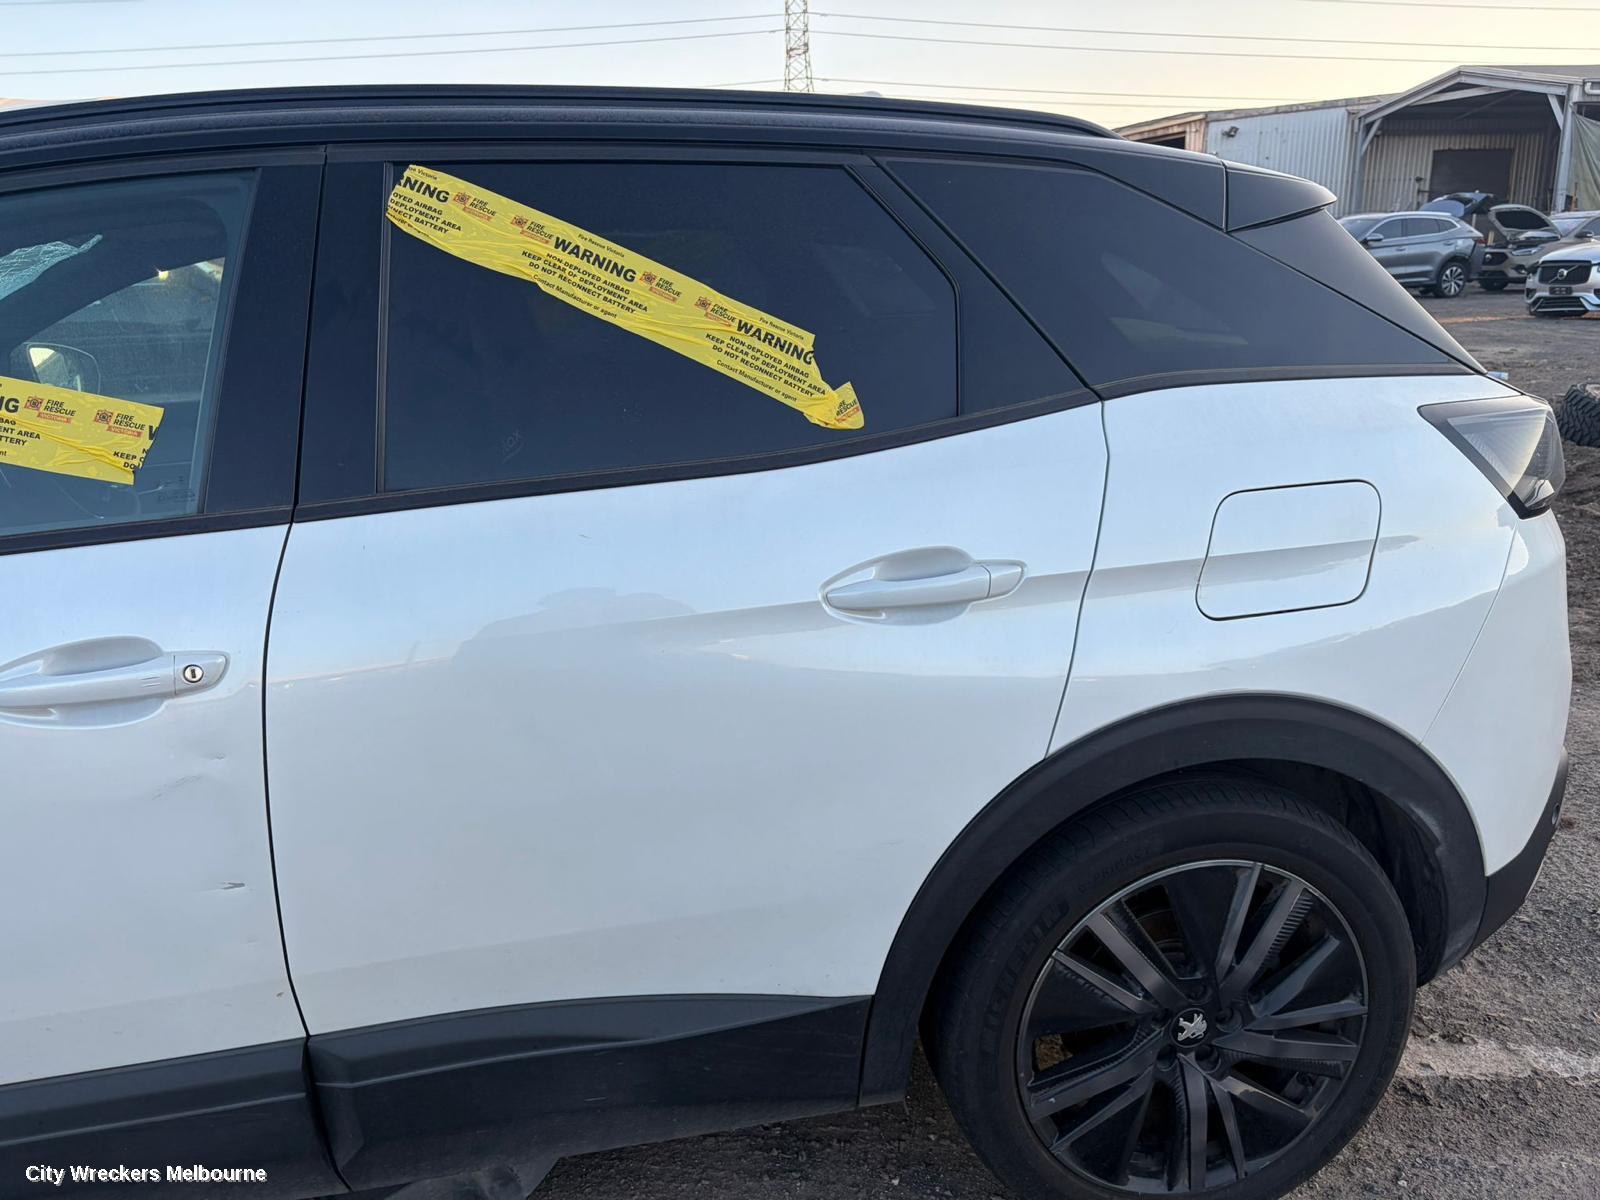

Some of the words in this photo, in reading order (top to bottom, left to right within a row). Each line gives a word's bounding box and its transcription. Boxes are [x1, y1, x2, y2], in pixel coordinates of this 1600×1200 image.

[400, 176, 450, 203] NING
[414, 201, 443, 216] AIRBAG
[469, 201, 497, 217] RESCUE
[473, 197, 488, 207] FIRE
[390, 198, 441, 222] DEPLOYMENT
[441, 220, 462, 231] AREA
[414, 216, 449, 234] BATTERY
[526, 225, 555, 240] RESCUE
[530, 221, 546, 230] FIRE
[554, 236, 637, 283] WARNING
[606, 246, 625, 258] Victoria
[521, 250, 542, 262] KEEP
[543, 259, 567, 274] CLEAR
[579, 276, 628, 302] DEPLOYMENT
[628, 299, 648, 312] AREA
[546, 253, 602, 282] NON-DEPLOYED
[602, 280, 631, 295] AIRBAG
[658, 277, 675, 287] FIRE
[528, 261, 540, 270] DO
[541, 266, 558, 277] NOT
[558, 274, 603, 299] RECONNECT
[602, 296, 636, 314] BATTERY
[655, 282, 682, 297] RESCUE
[533, 274, 556, 289] Contact
[555, 285, 593, 308] Manufacturer
[600, 308, 618, 319] agent
[710, 307, 736, 323] RESCUE
[736, 320, 814, 365] WARNING
[705, 333, 725, 345] KEEP
[726, 342, 750, 358] CLEAR
[750, 354, 760, 363] OF
[761, 360, 807, 386] DEPLOYMENT
[807, 383, 826, 396] AREA
[729, 336, 783, 365] NON-DEPLOYED
[783, 362, 810, 379] AIRBAG
[712, 344, 723, 353] DO
[724, 350, 739, 360] NOT
[740, 357, 782, 382] RECONNECT
[783, 379, 815, 398] BATTERY
[716, 360, 738, 374] Contact
[739, 369, 774, 391] Manufacturer
[781, 391, 798, 403] agent
[44, 405, 76, 417] RESCUE
[46, 399, 65, 409] FIRE
[113, 418, 146, 431] RESCUE
[116, 412, 135, 422] FIRE
[17, 429, 41, 440] AREA
[113, 450, 137, 461] KEEP
